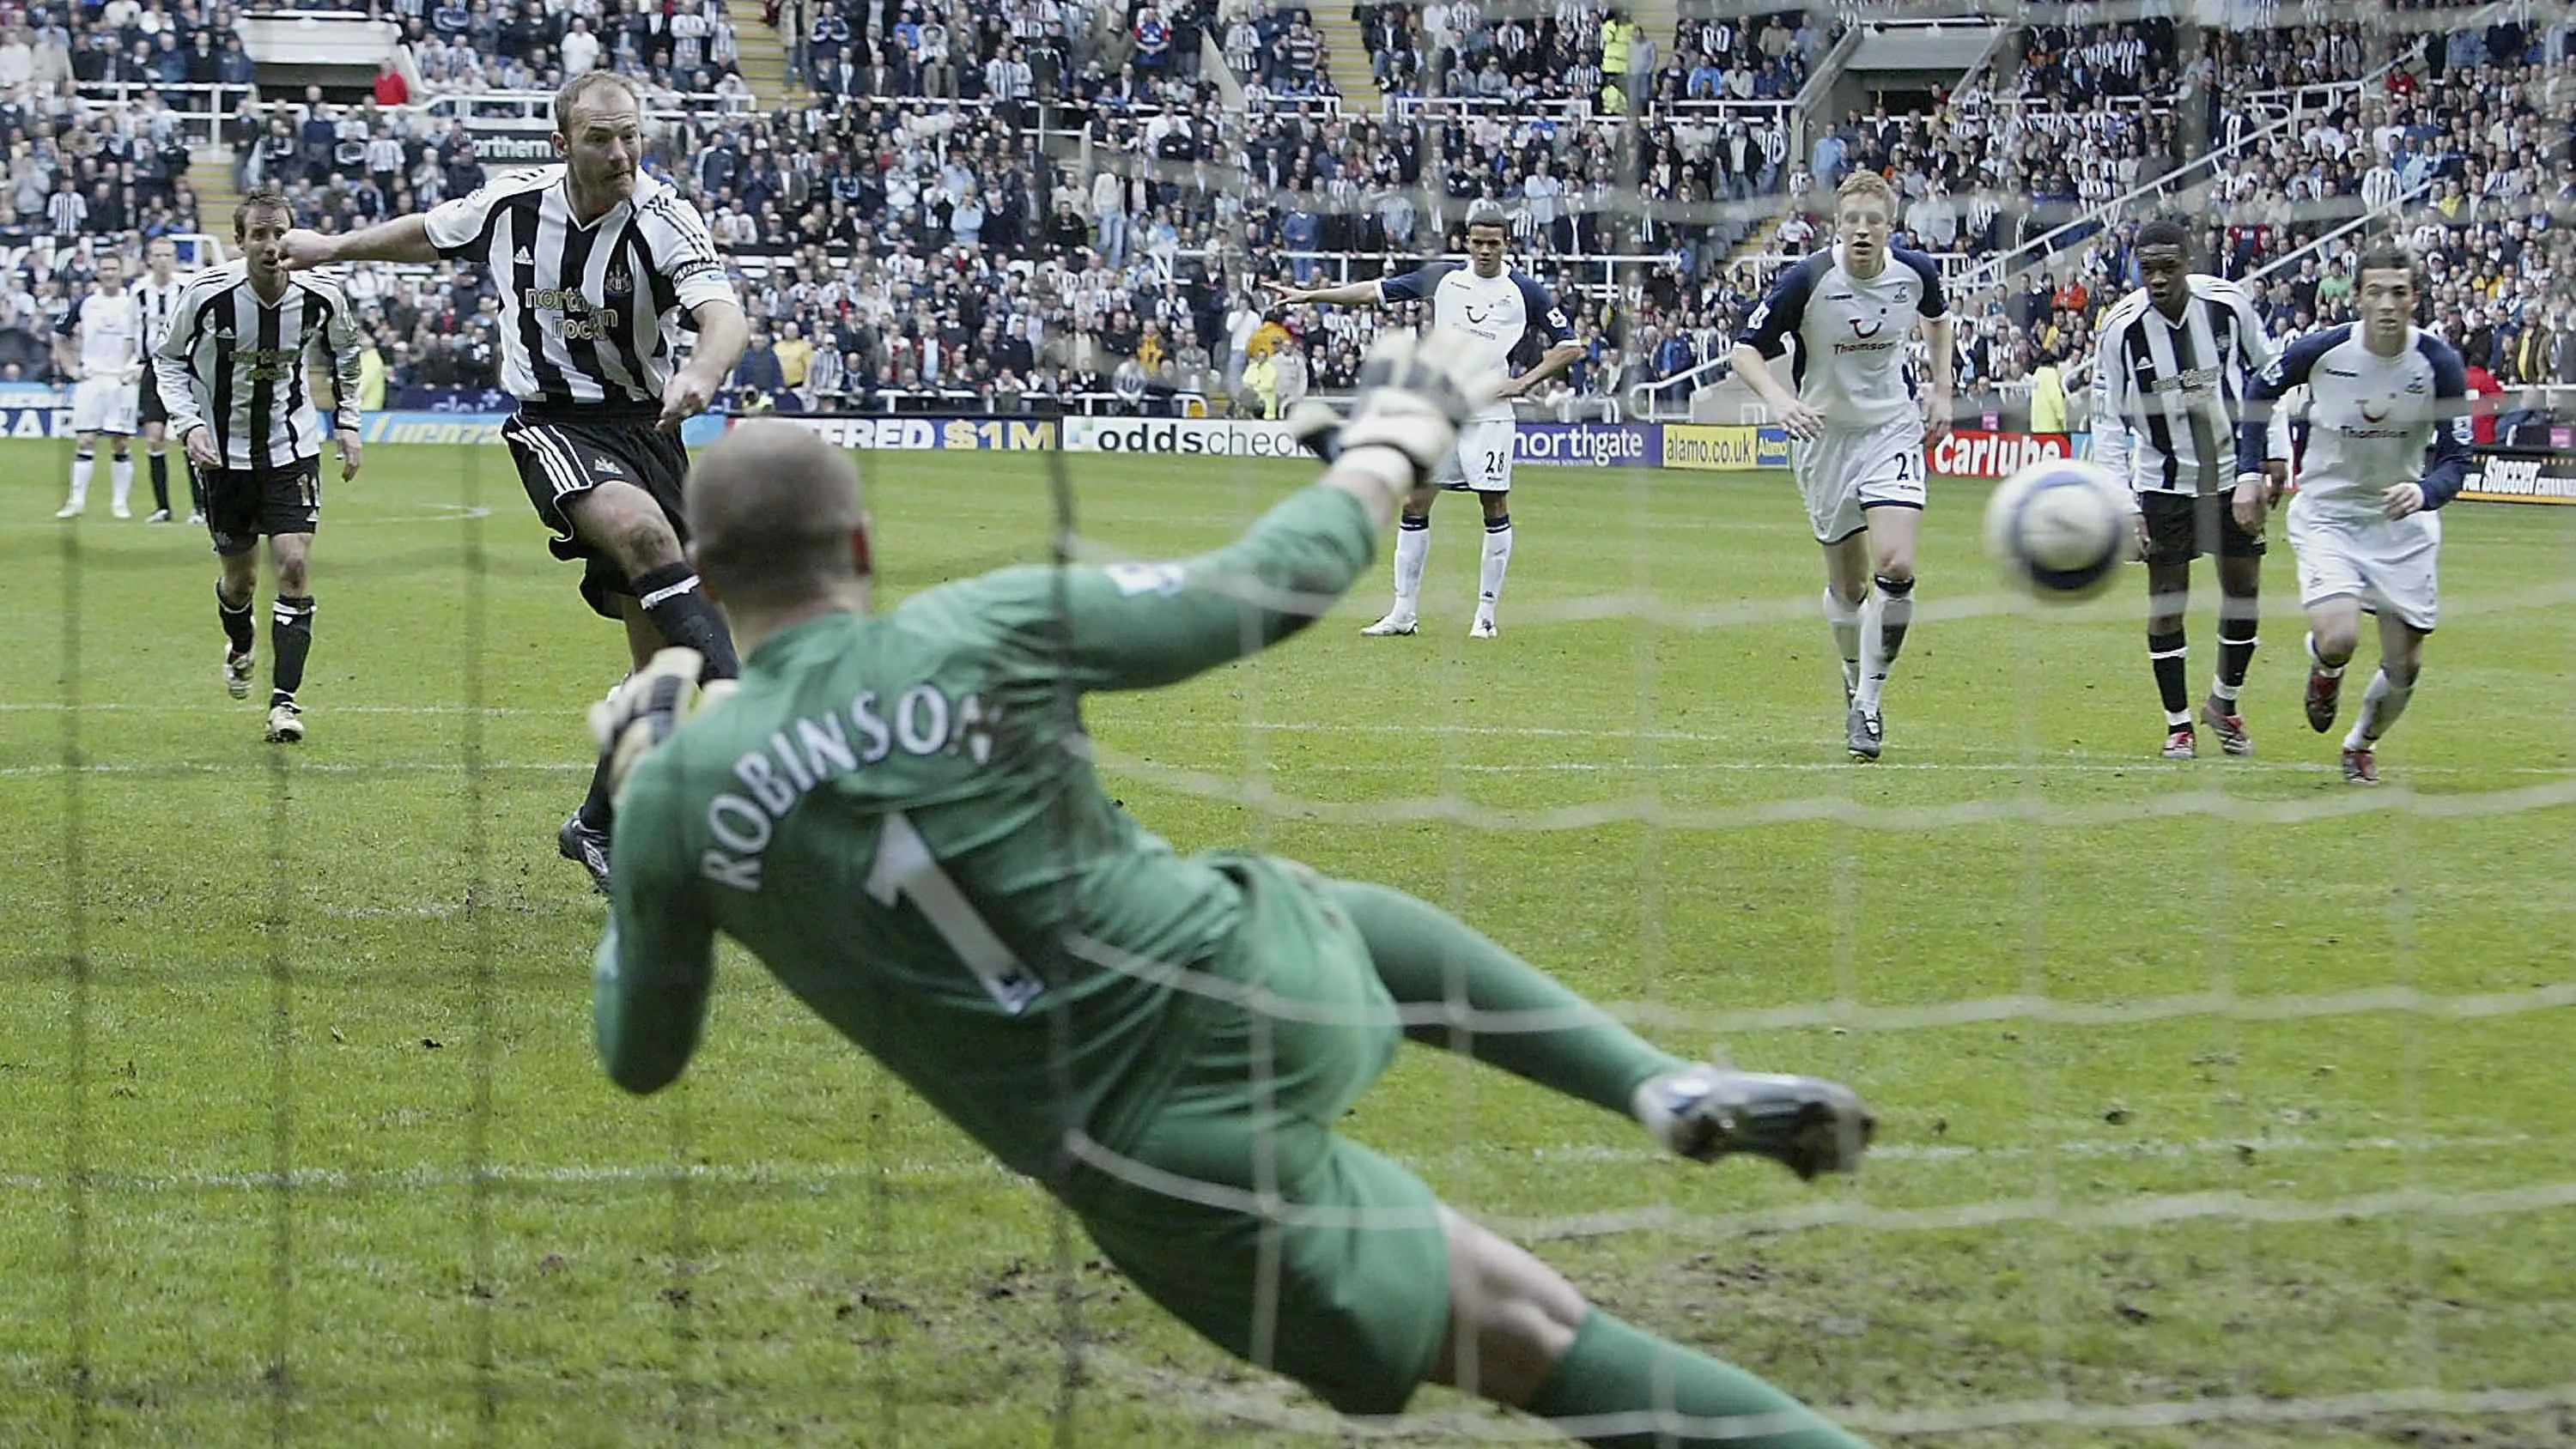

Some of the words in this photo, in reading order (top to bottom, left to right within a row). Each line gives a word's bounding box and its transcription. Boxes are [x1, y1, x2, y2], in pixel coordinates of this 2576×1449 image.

[471, 135, 552, 158] orthern
[803, 419, 935, 449] ERED
[945, 419, 1056, 451] $1M
[1097, 423, 1313, 456] oddscheck
[1514, 423, 1643, 467] northgate
[1667, 433, 1751, 464] alamo.co.uk
[1485, 451, 1505, 474] 28
[866, 810, 1046, 1016] 1
